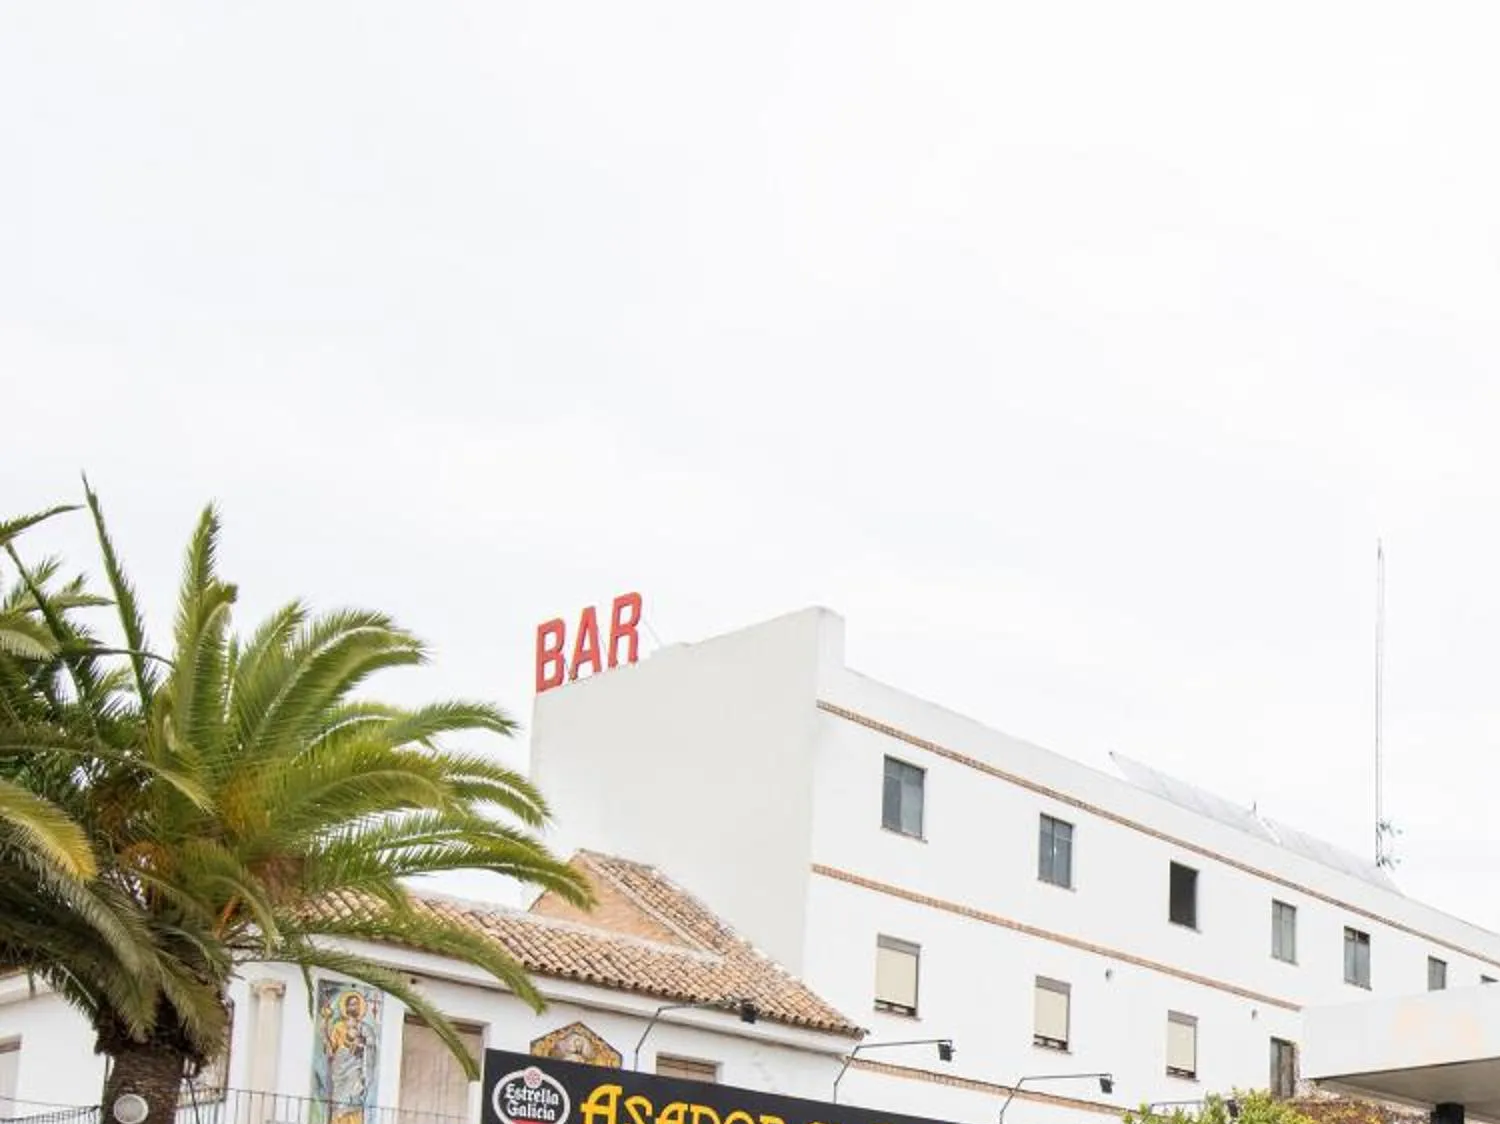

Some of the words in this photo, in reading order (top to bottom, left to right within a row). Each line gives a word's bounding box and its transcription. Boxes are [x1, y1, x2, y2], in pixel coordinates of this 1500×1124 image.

[536, 592, 642, 693] BAR
[505, 1083, 559, 1105] Estrella
[506, 1099, 555, 1121] Galicia
